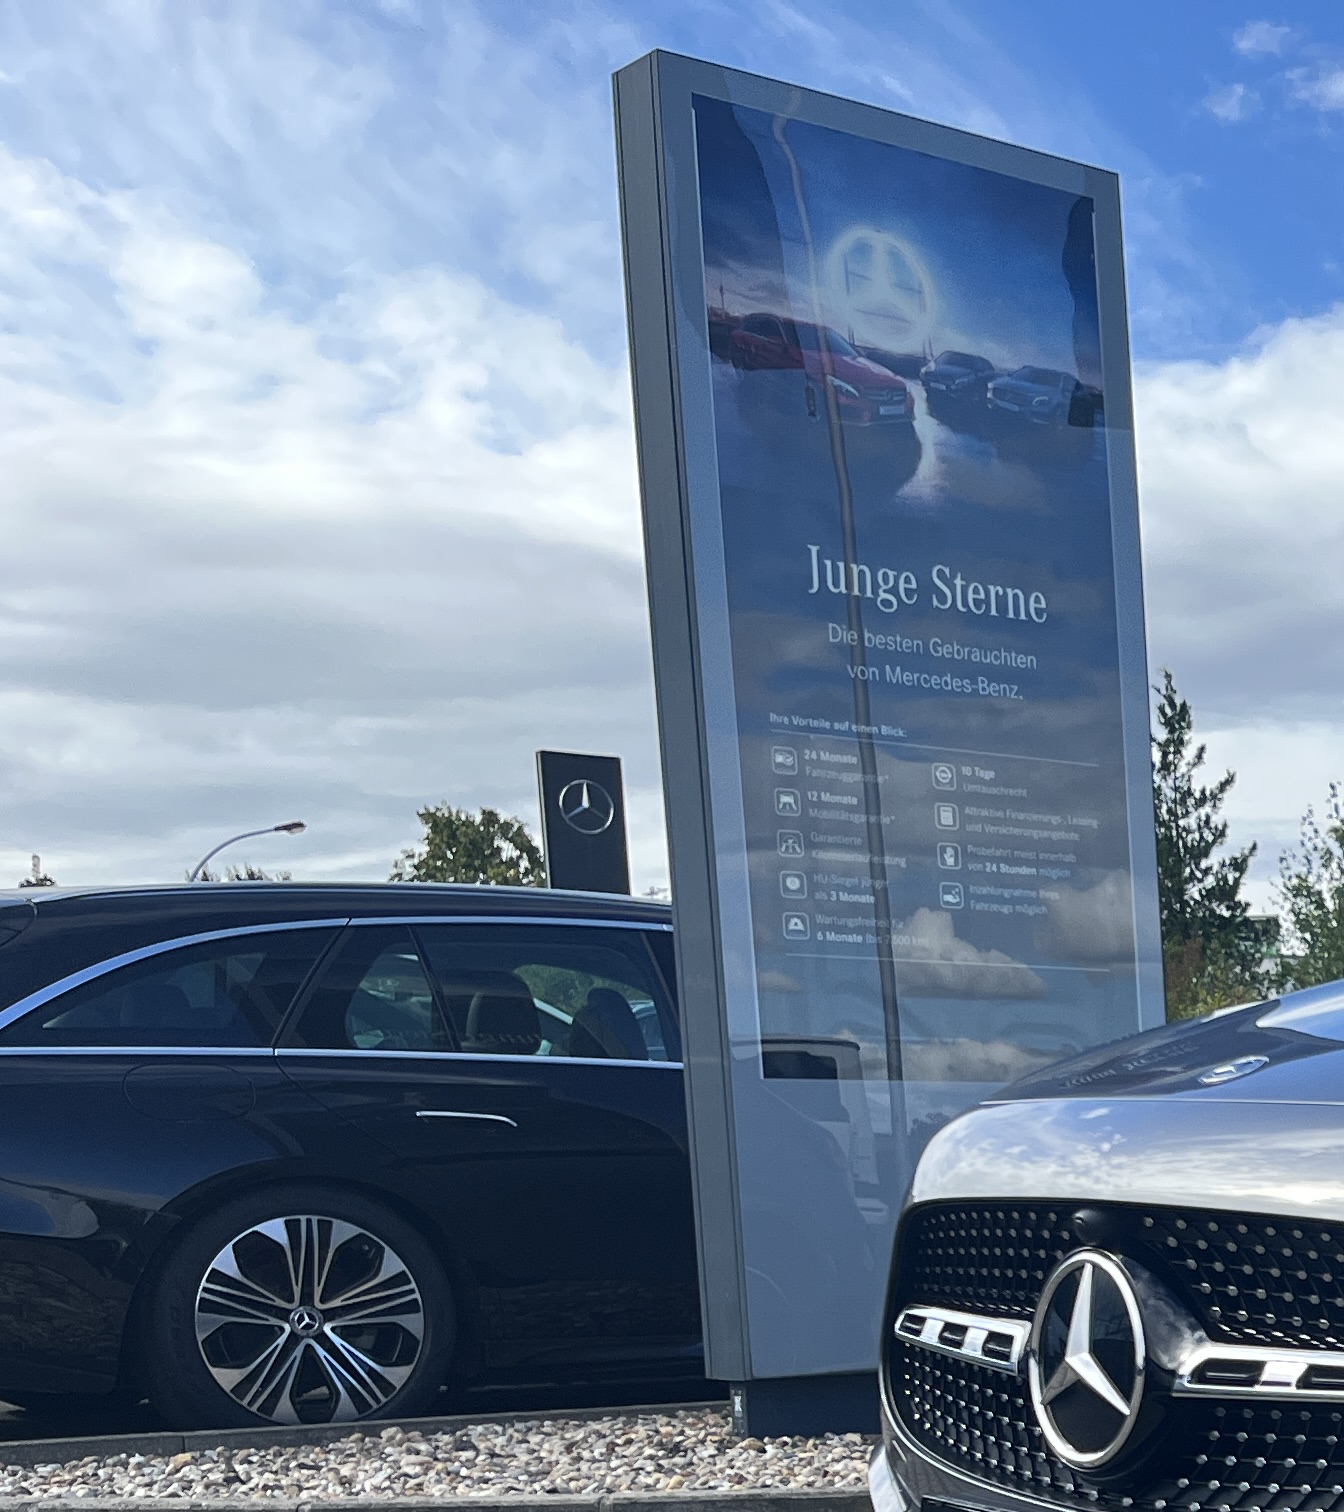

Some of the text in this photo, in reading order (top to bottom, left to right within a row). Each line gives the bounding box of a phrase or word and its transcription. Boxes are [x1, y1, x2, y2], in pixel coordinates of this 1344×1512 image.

[807, 544, 1047, 623] Junge Sterne
[828, 623, 1037, 670] Die besten Gebrauchten
[847, 664, 1024, 700] von Mercedes-Benz.
[769, 712, 789, 725] Ihre
[791, 715, 831, 729] Vorteile
[833, 721, 849, 731] auf
[851, 724, 879, 734] einen
[804, 749, 858, 764] 24 Monate
[961, 766, 996, 781] 10 Tage
[807, 790, 858, 806] 12 Monate
[963, 783, 1028, 798] Umtauschrecht
[966, 823, 982, 833] und
[1014, 850, 1037, 861] meist
[967, 863, 984, 872] von
[985, 862, 997, 873] 24
[1000, 863, 1037, 876] Stunden
[830, 890, 837, 901] 3
[839, 891, 876, 904] Monate
[816, 931, 824, 941] 6
[826, 932, 863, 944] Monate
